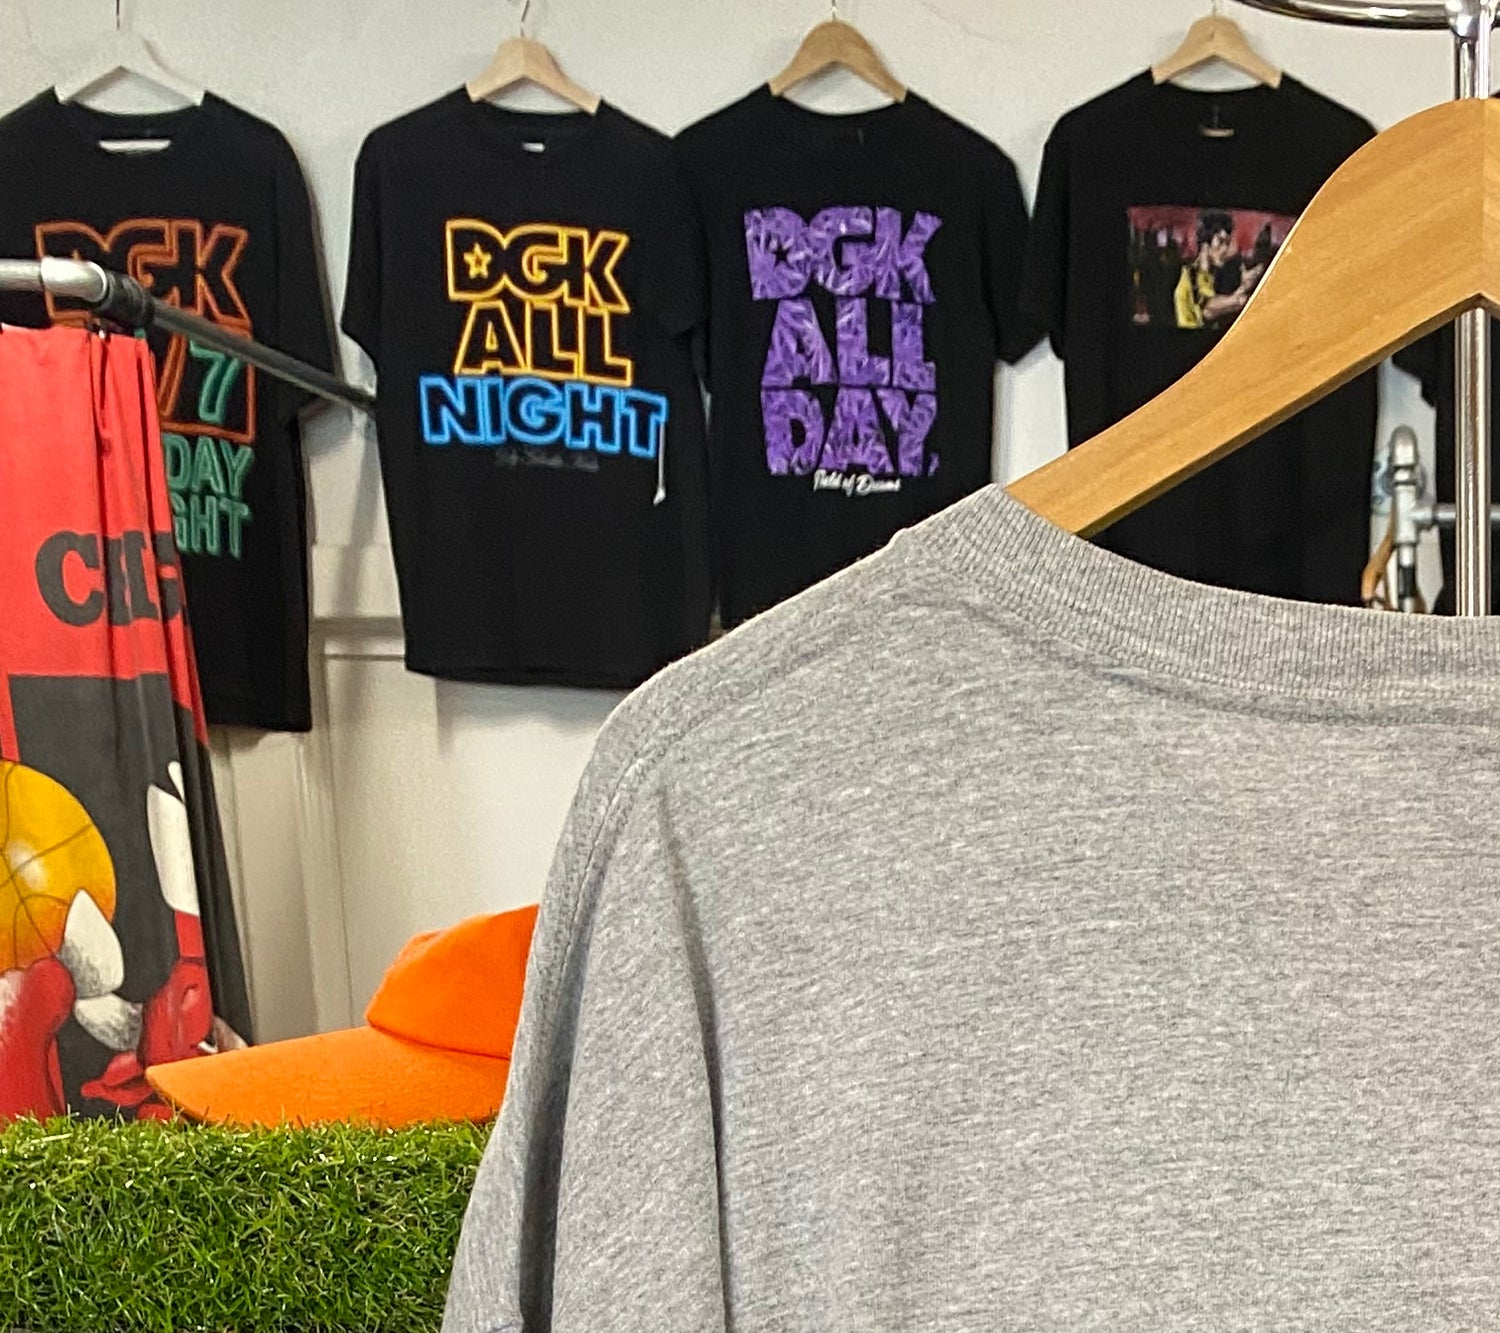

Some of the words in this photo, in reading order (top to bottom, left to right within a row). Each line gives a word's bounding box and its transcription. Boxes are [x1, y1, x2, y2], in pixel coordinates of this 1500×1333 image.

[446, 218, 631, 314] DGK
[744, 206, 942, 305] DGK
[453, 299, 633, 388] ALL
[760, 297, 937, 391] ALL
[419, 375, 668, 459] NIGHT
